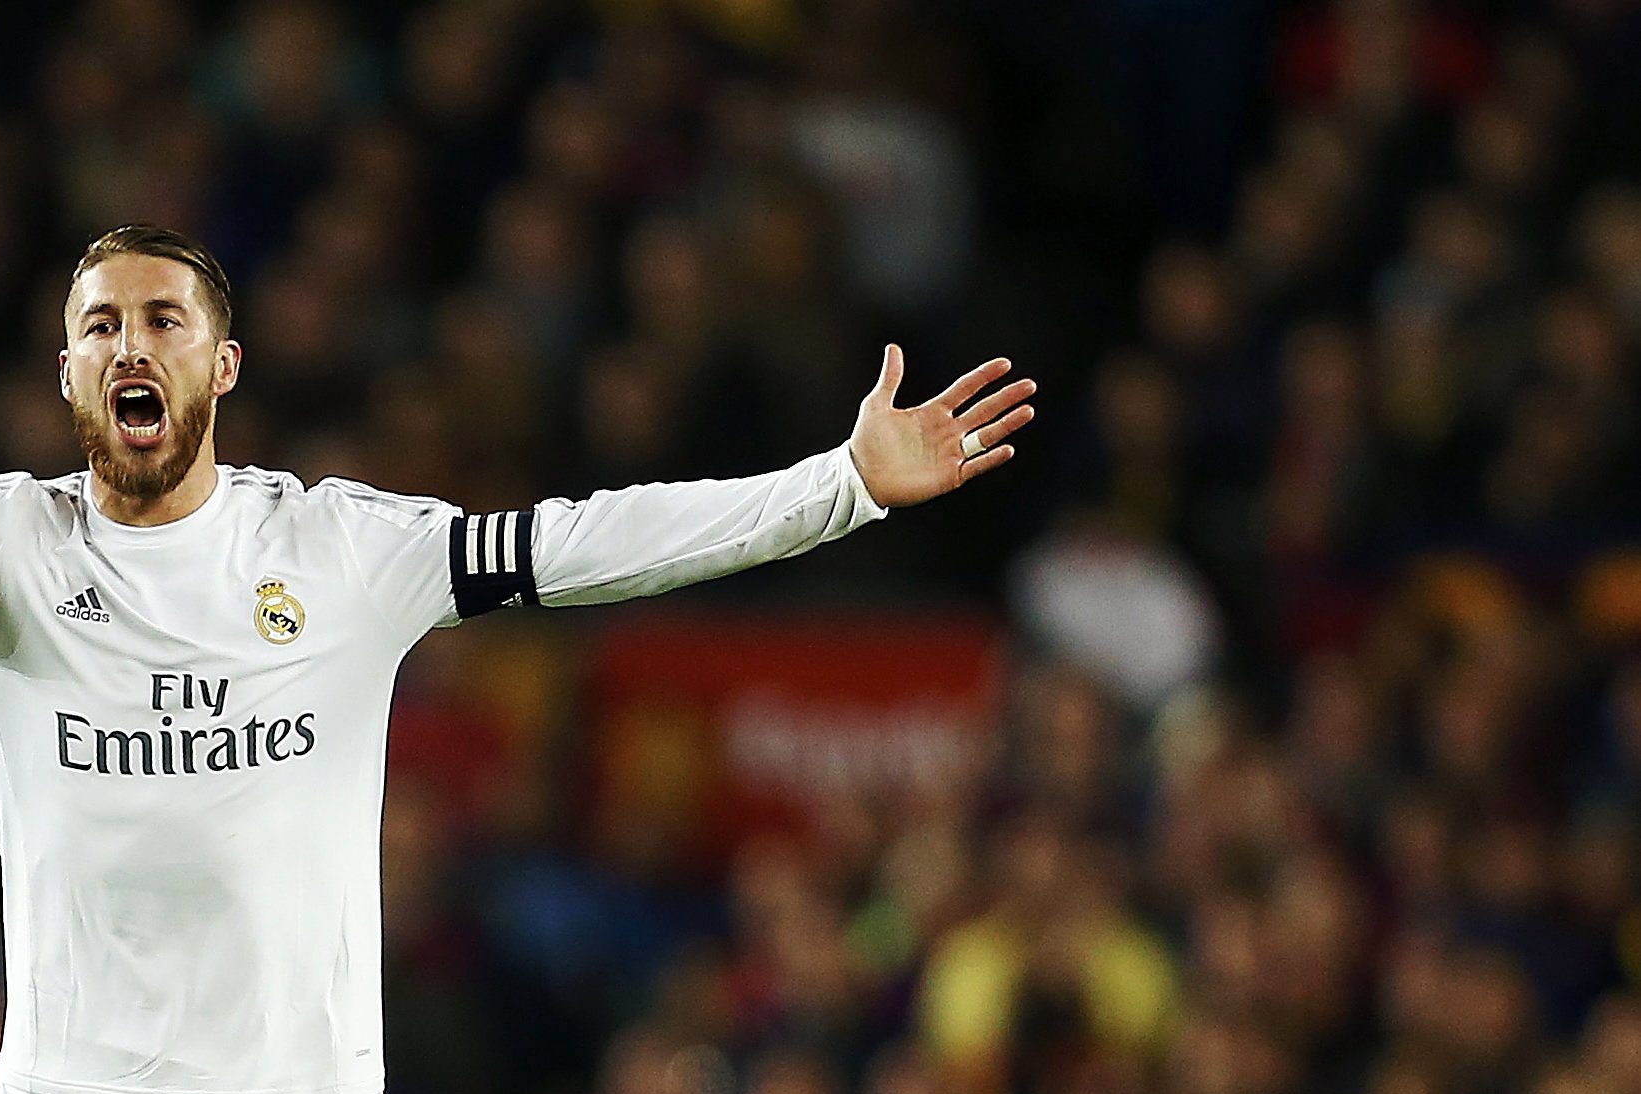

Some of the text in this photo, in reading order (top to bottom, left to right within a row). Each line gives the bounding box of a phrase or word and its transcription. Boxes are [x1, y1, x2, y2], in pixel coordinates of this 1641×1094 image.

[56, 605, 110, 623] adidas
[151, 674, 228, 717] Fly
[55, 711, 315, 775] Emirates
